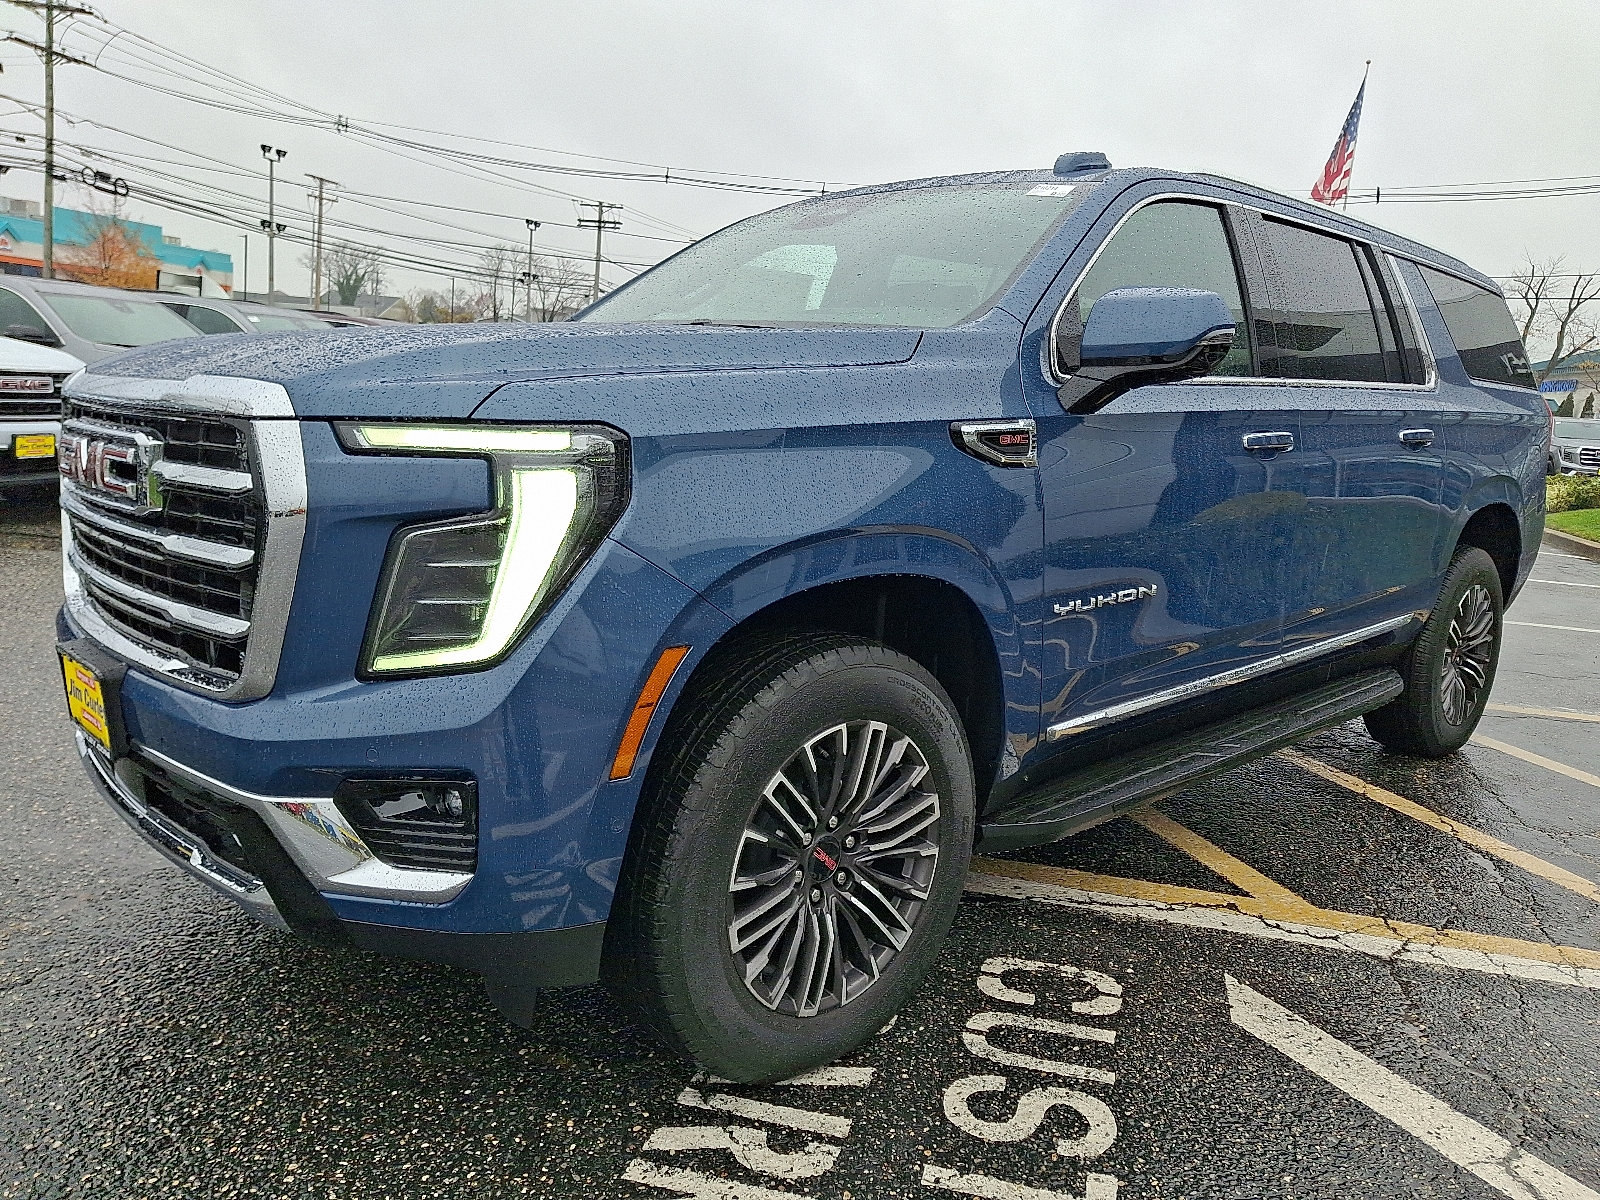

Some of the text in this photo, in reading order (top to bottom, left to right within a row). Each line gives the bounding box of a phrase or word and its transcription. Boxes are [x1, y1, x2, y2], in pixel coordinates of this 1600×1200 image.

[1, 380, 51, 391] GMC
[1000, 434, 1028, 444] GMC
[59, 437, 137, 500] GMC
[1053, 584, 1158, 616] YUKON
[813, 847, 837, 871] GMC
